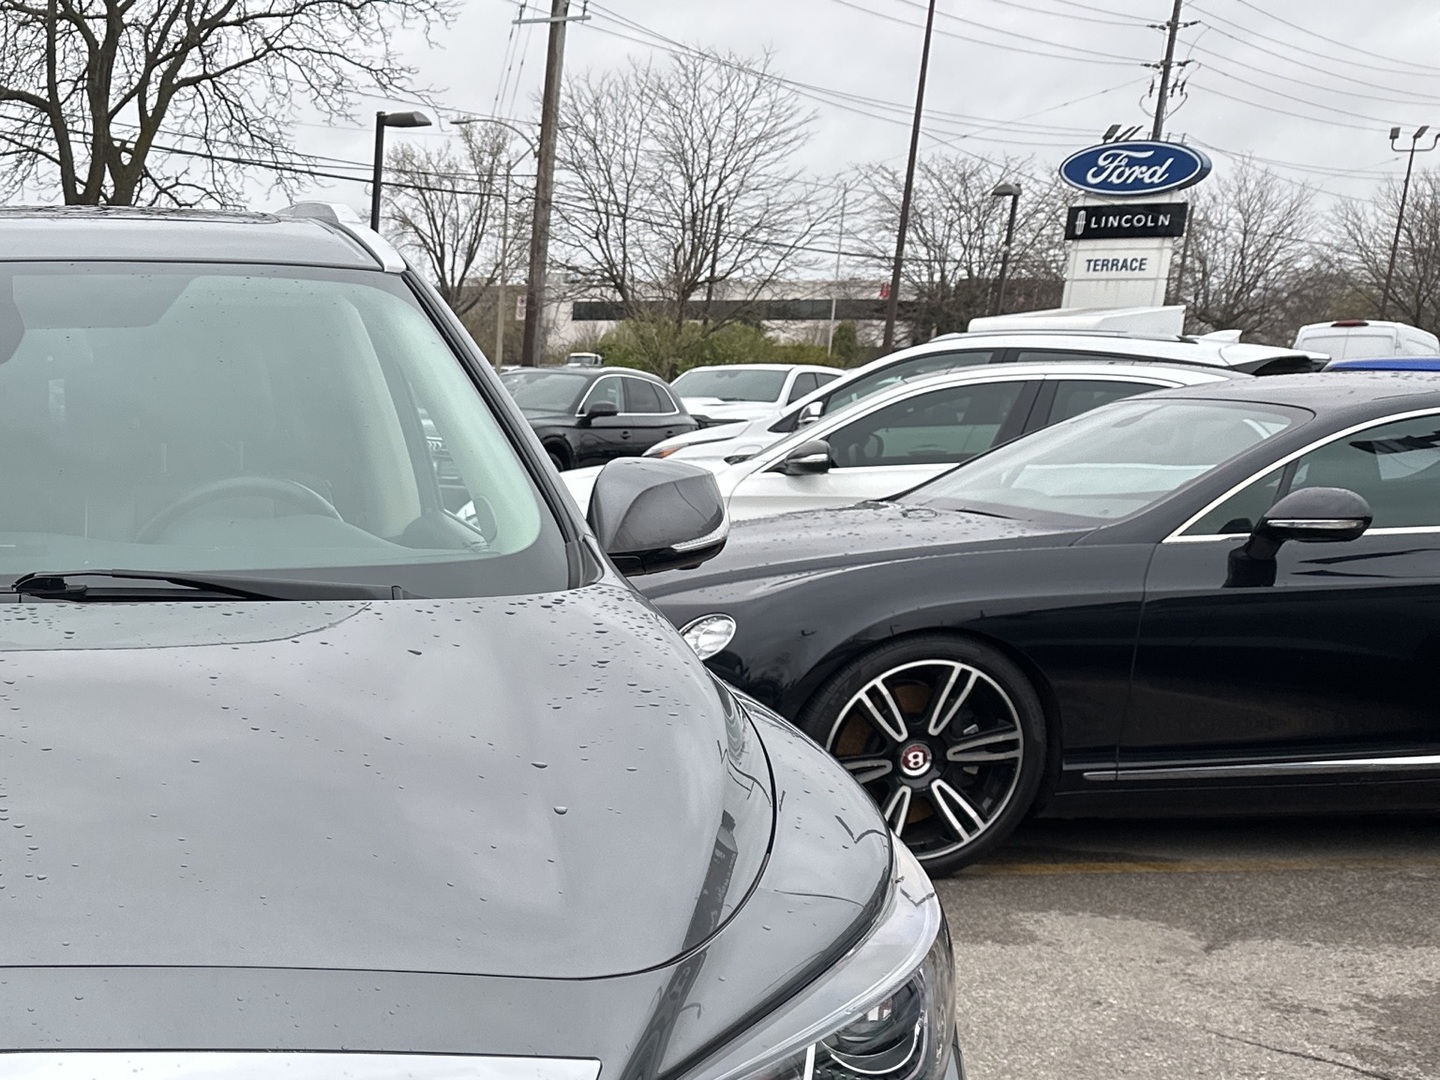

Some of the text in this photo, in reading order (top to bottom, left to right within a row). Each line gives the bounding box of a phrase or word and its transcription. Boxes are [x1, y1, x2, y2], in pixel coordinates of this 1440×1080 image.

[1086, 149, 1174, 185] Ford
[1090, 214, 1171, 229] LINCOLN
[1086, 258, 1148, 273] TERRACE
